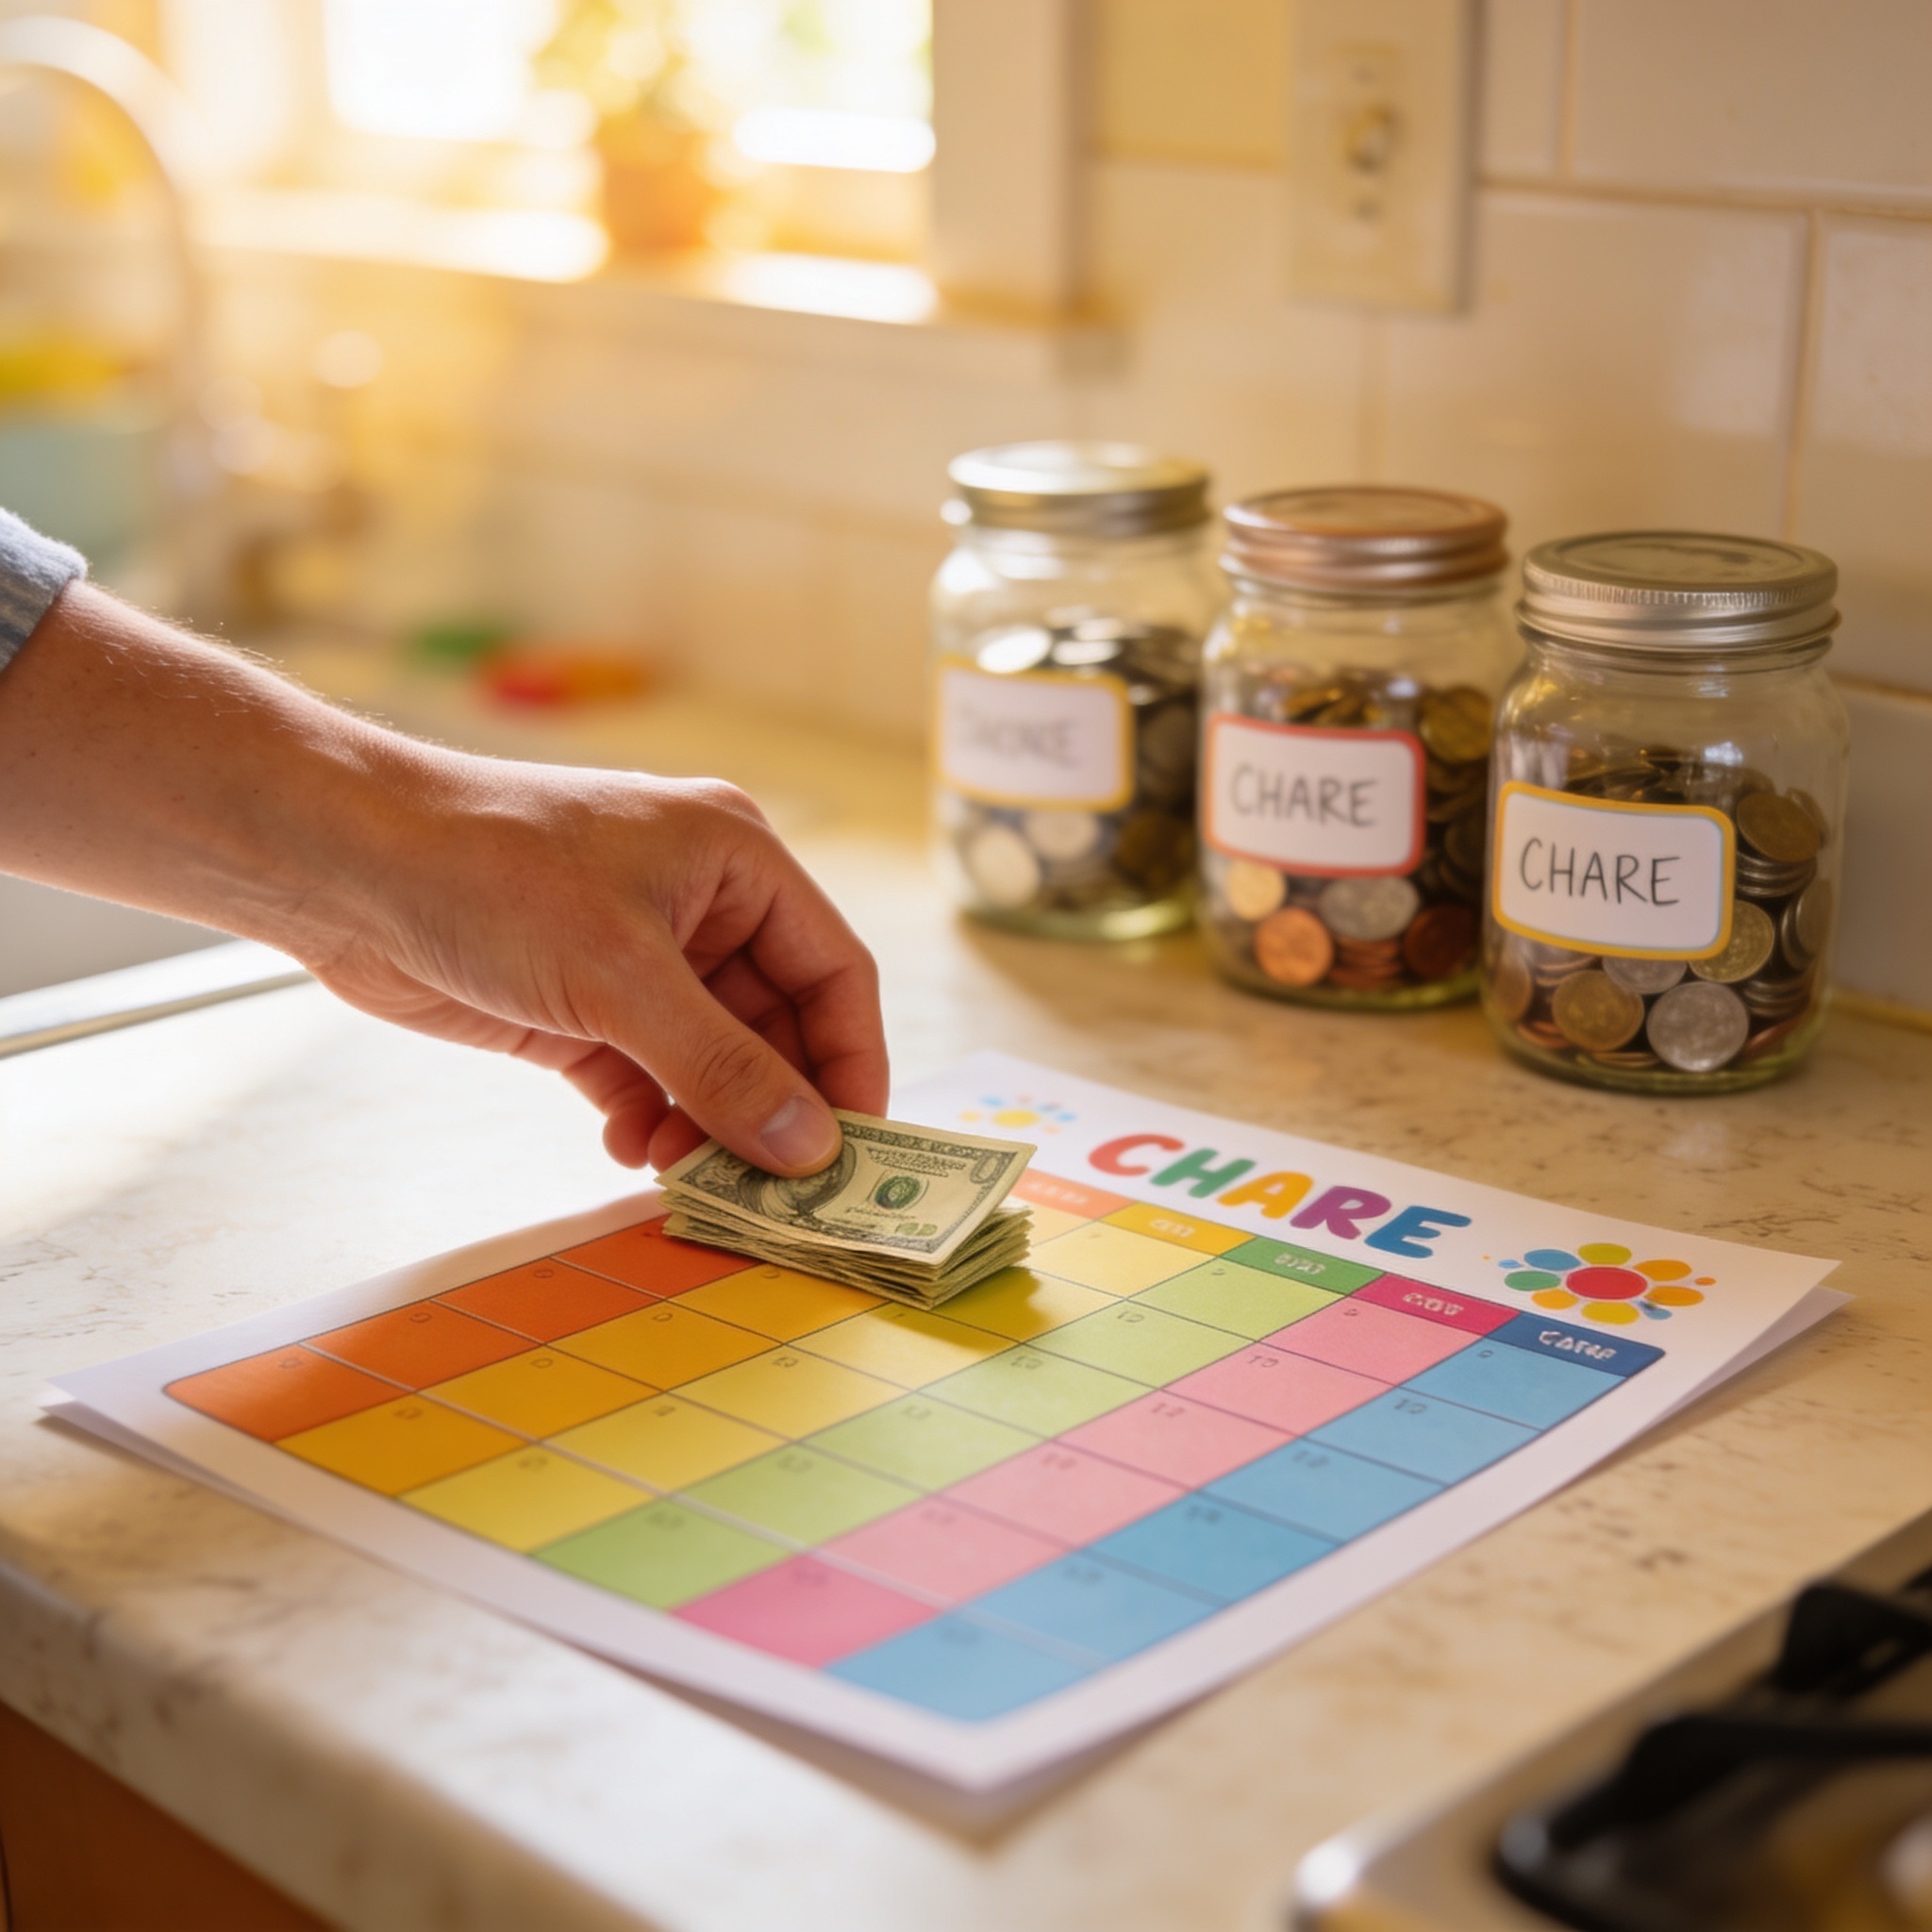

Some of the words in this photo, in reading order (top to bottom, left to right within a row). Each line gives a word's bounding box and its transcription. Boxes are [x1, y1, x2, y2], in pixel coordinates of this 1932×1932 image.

[1230, 760, 1378, 827] CHARE
[1520, 837, 1681, 907] CHARE
[1088, 1132, 1473, 1259] CHARE
